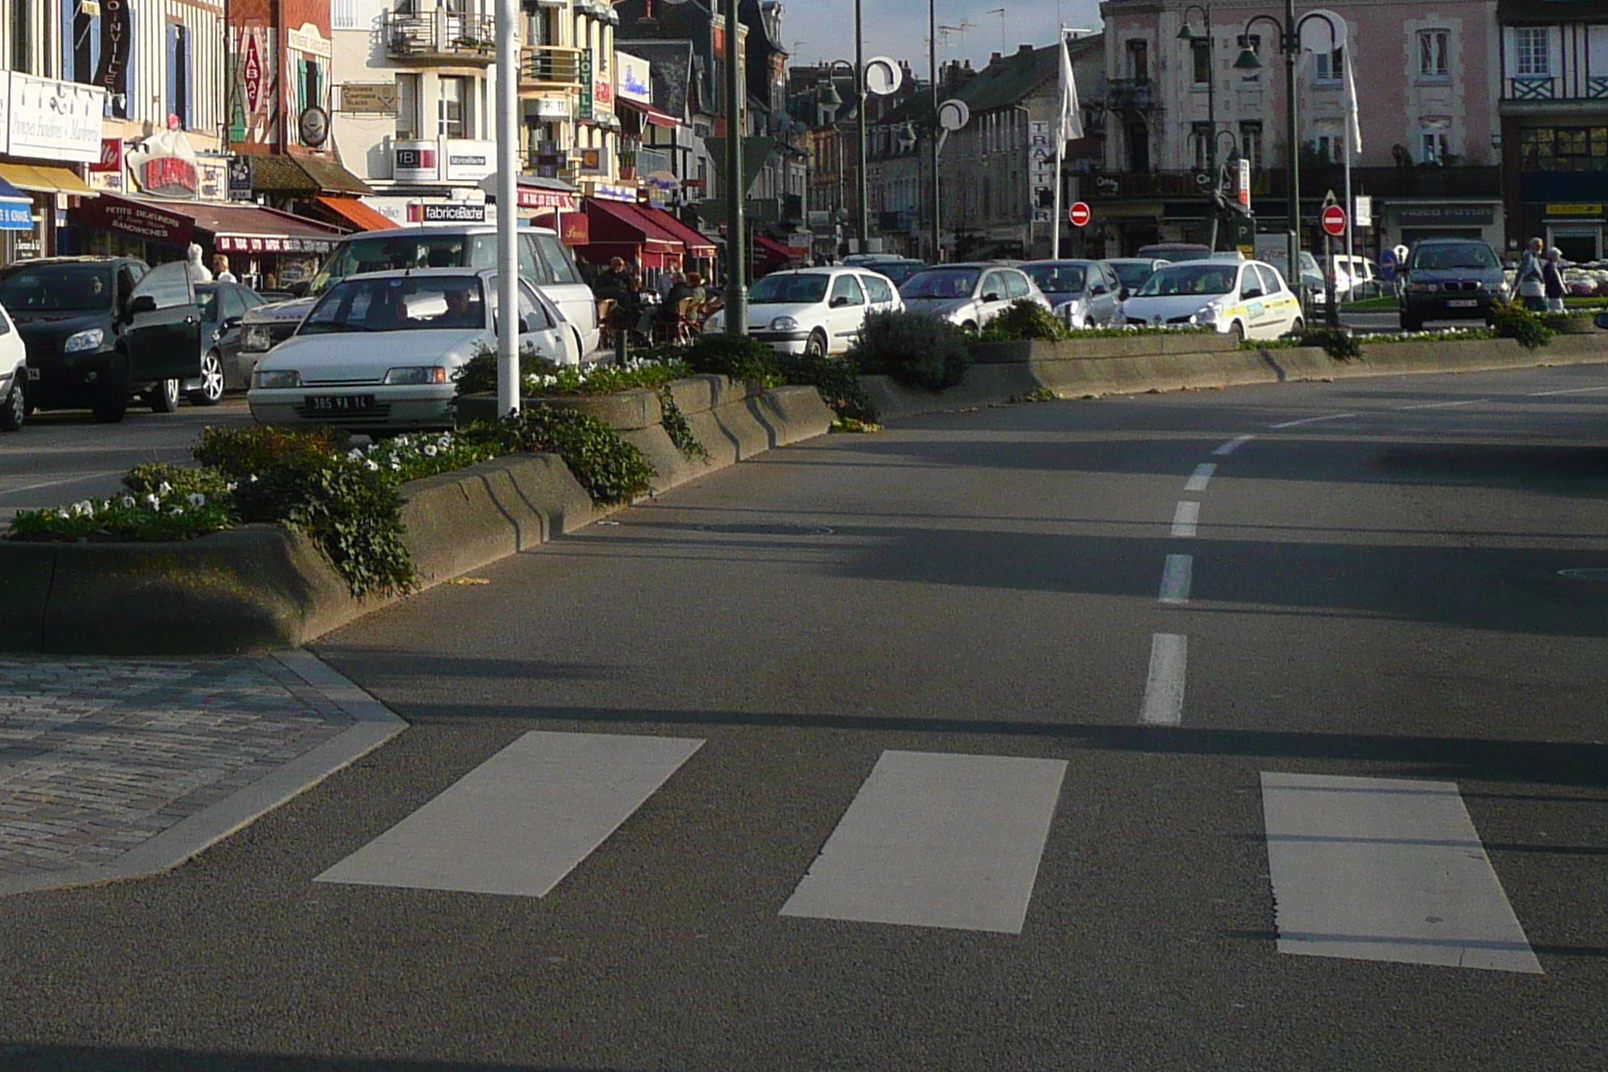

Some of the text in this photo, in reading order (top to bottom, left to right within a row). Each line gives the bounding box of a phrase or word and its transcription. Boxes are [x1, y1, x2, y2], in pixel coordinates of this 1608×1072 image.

[247, 48, 258, 100] TABAC
[580, 51, 591, 106] HOTEL
[105, 205, 180, 228] PETITS DEJEUNERS
[425, 206, 484, 220] fabriceBacher
[111, 220, 169, 238] SANDWICHES
